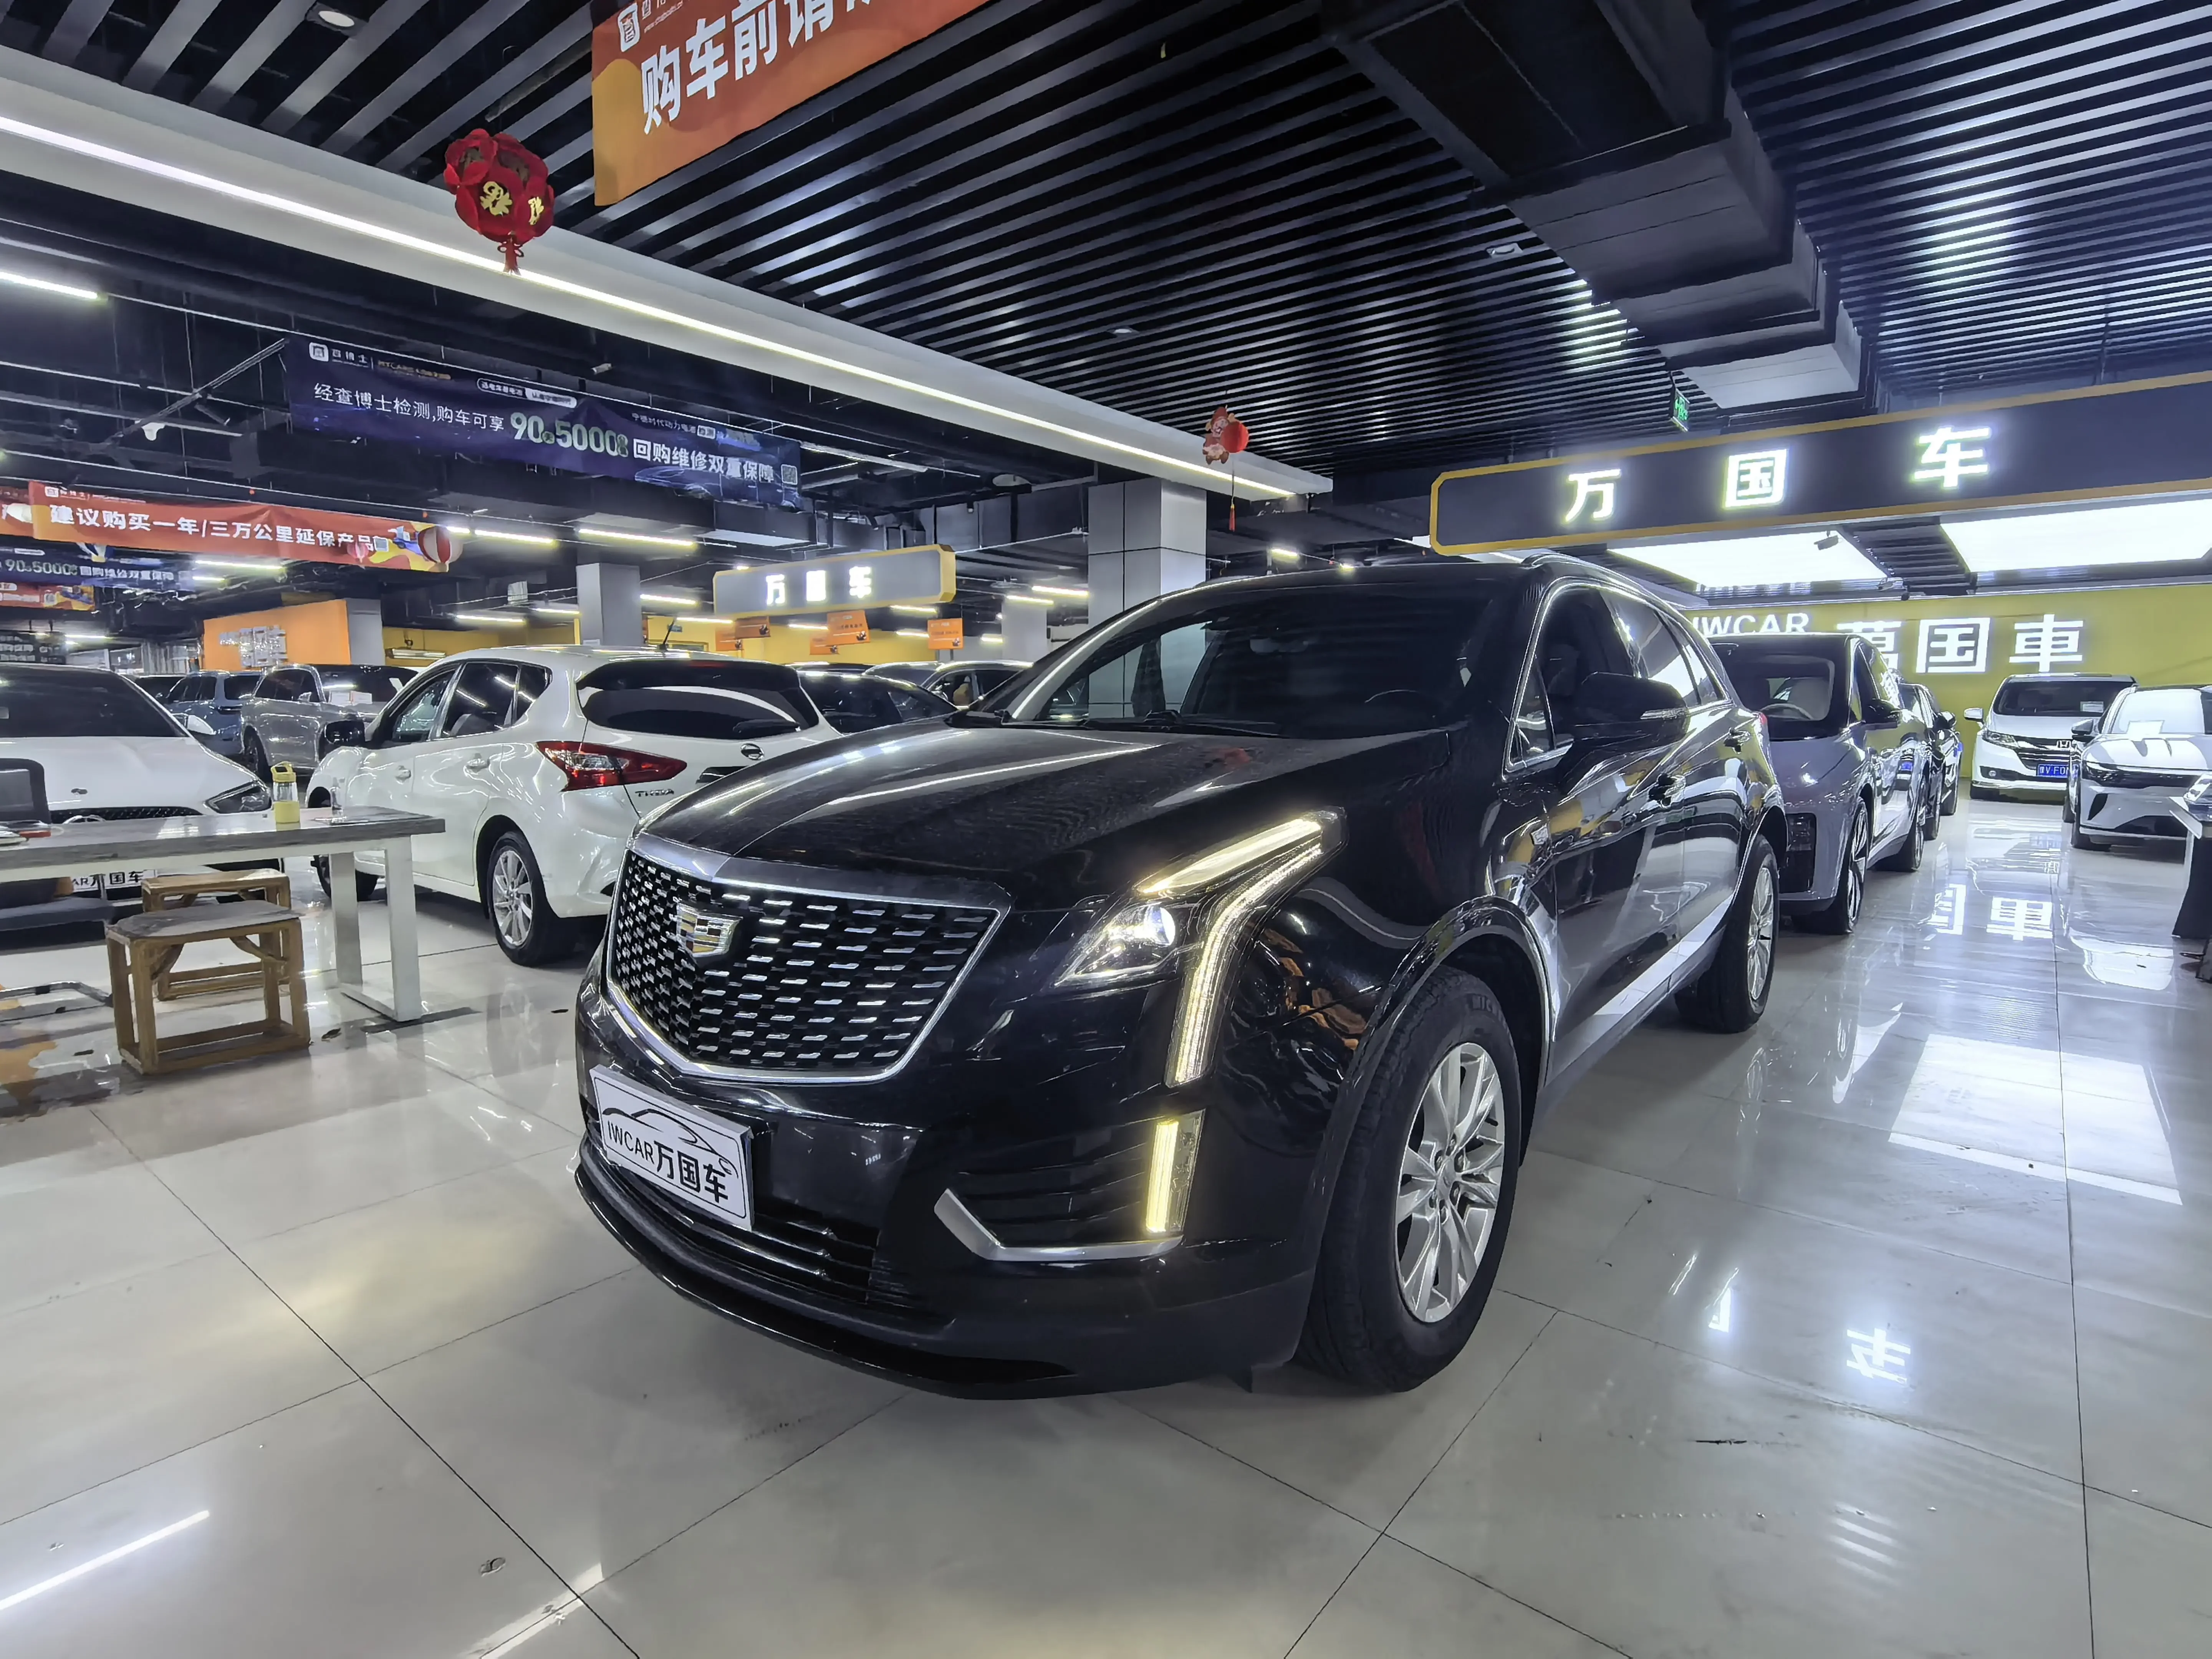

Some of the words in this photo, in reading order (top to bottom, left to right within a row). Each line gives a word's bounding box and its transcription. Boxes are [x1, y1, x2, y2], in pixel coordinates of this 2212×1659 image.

[633, 438, 773, 483] 回购维修双重保障
[1563, 426, 1992, 523] 万国车
[766, 566, 872, 606] 万车
